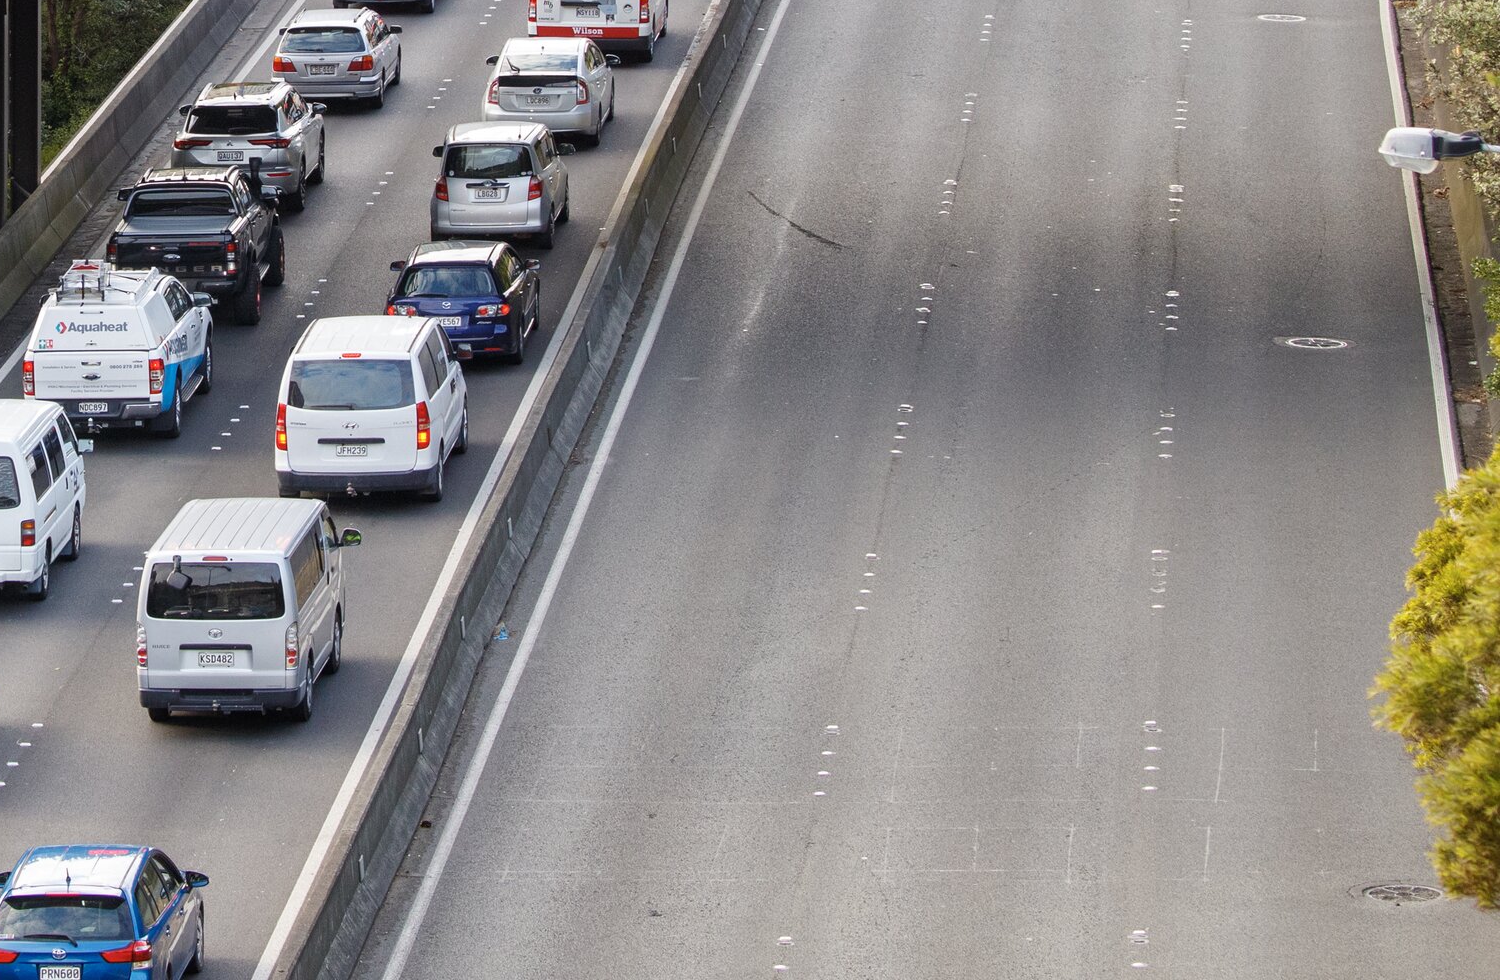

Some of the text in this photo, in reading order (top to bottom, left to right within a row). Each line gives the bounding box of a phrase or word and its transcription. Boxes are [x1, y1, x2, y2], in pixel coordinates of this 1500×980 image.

[572, 27, 603, 35] Wilson
[67, 321, 128, 334] Aquaheat
[79, 402, 108, 412] NDC897
[337, 446, 367, 454] JFH239
[200, 654, 233, 663] KSD482
[41, 968, 79, 979] PRN600
